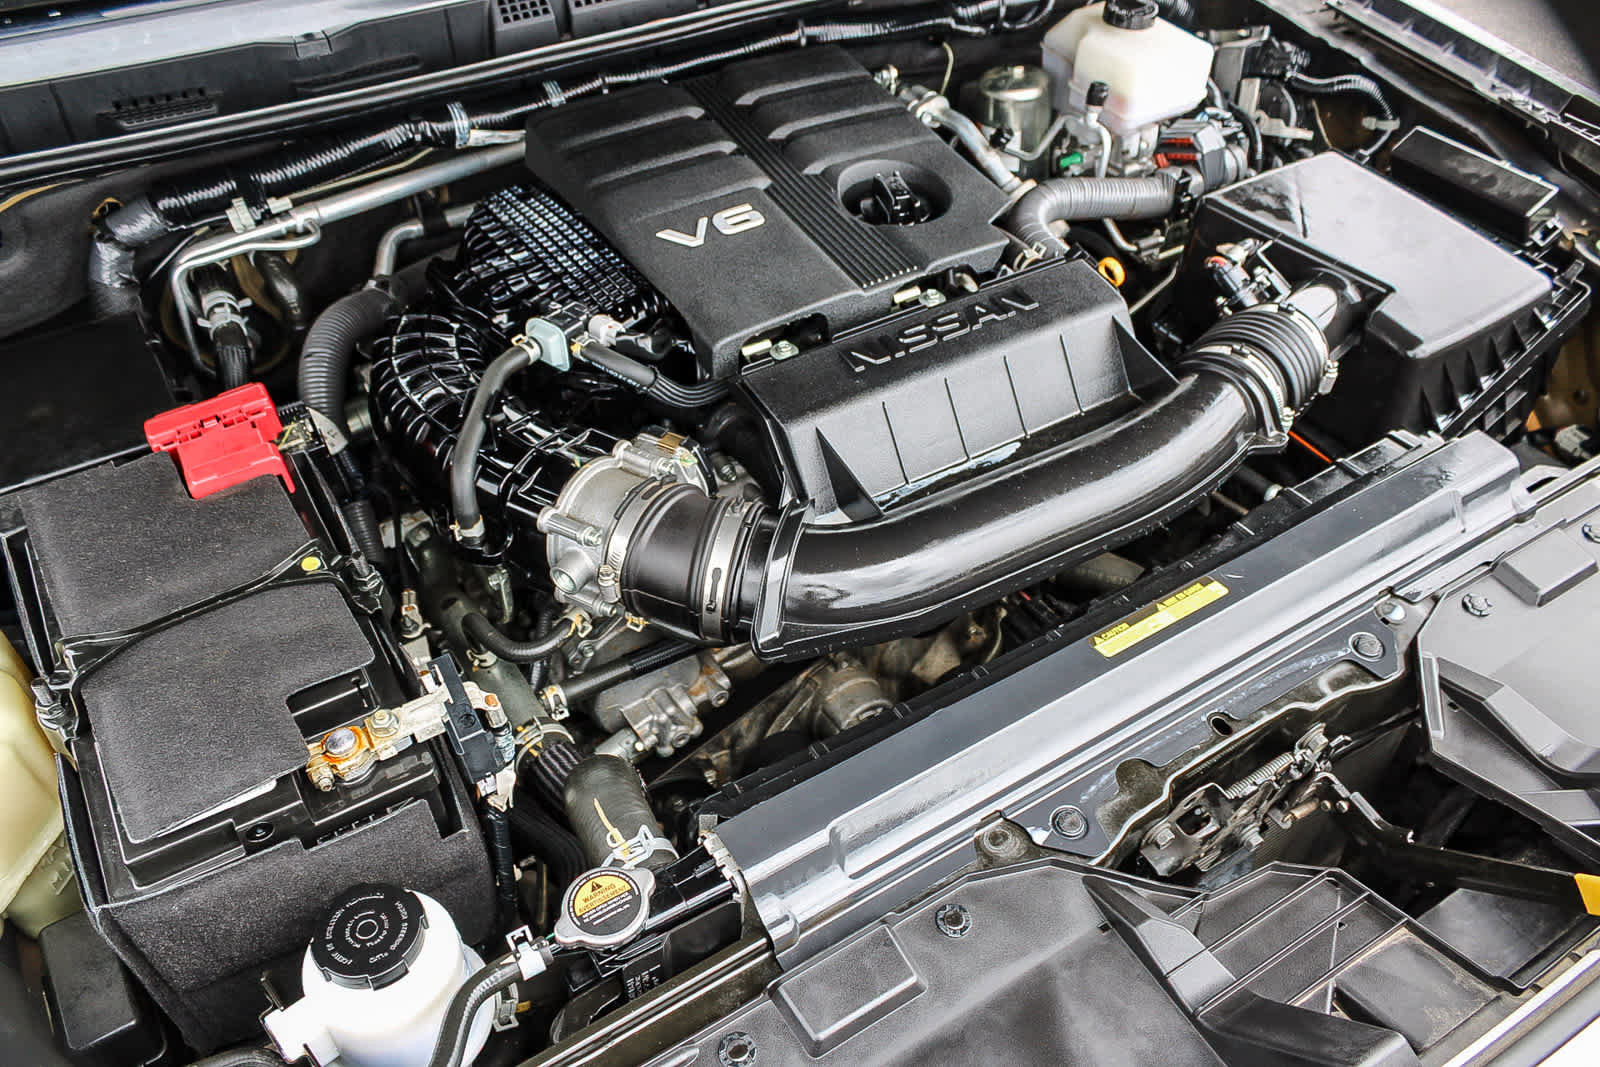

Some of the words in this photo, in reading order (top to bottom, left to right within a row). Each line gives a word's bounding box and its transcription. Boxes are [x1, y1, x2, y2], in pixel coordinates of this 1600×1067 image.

[655, 202, 766, 248] V6
[841, 291, 1040, 373] NISSAN
[583, 883, 616, 903] WARNING
